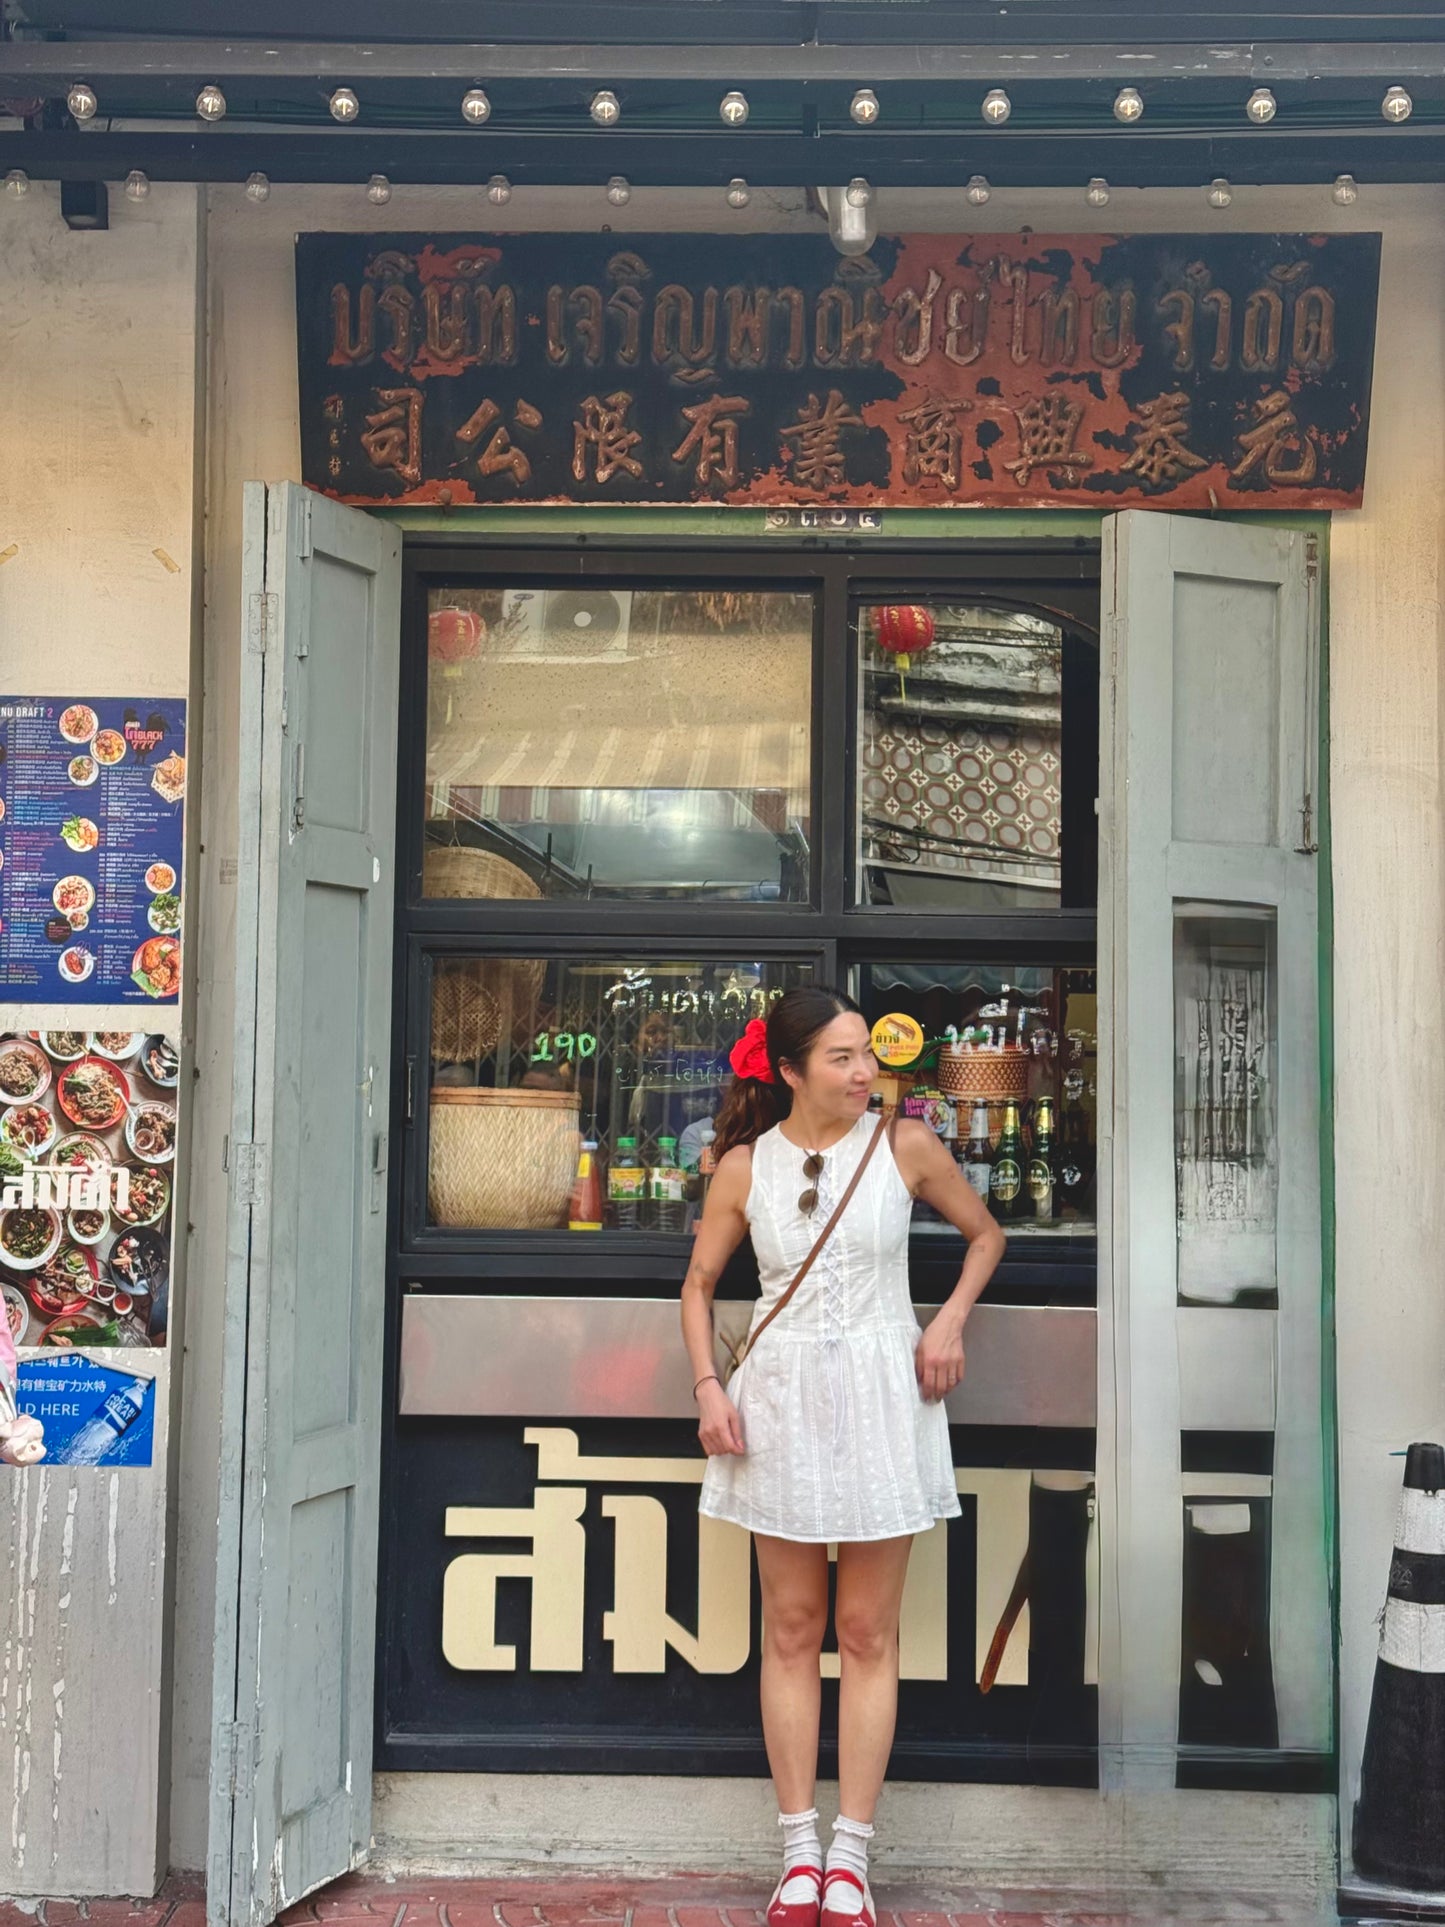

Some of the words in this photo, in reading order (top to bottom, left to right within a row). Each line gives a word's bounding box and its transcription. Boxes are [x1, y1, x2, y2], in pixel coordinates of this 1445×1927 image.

[330, 249, 518, 366] บริษัท
[1158, 260, 1337, 371] จำกัด
[16, 706, 45, 718] DRAFT
[47, 707, 54, 719] 2
[131, 740, 156, 750] 777
[531, 1032, 597, 1062] 190
[3, 1159, 130, 1210] ส้มตำ
[41, 1403, 80, 1417] HERE
